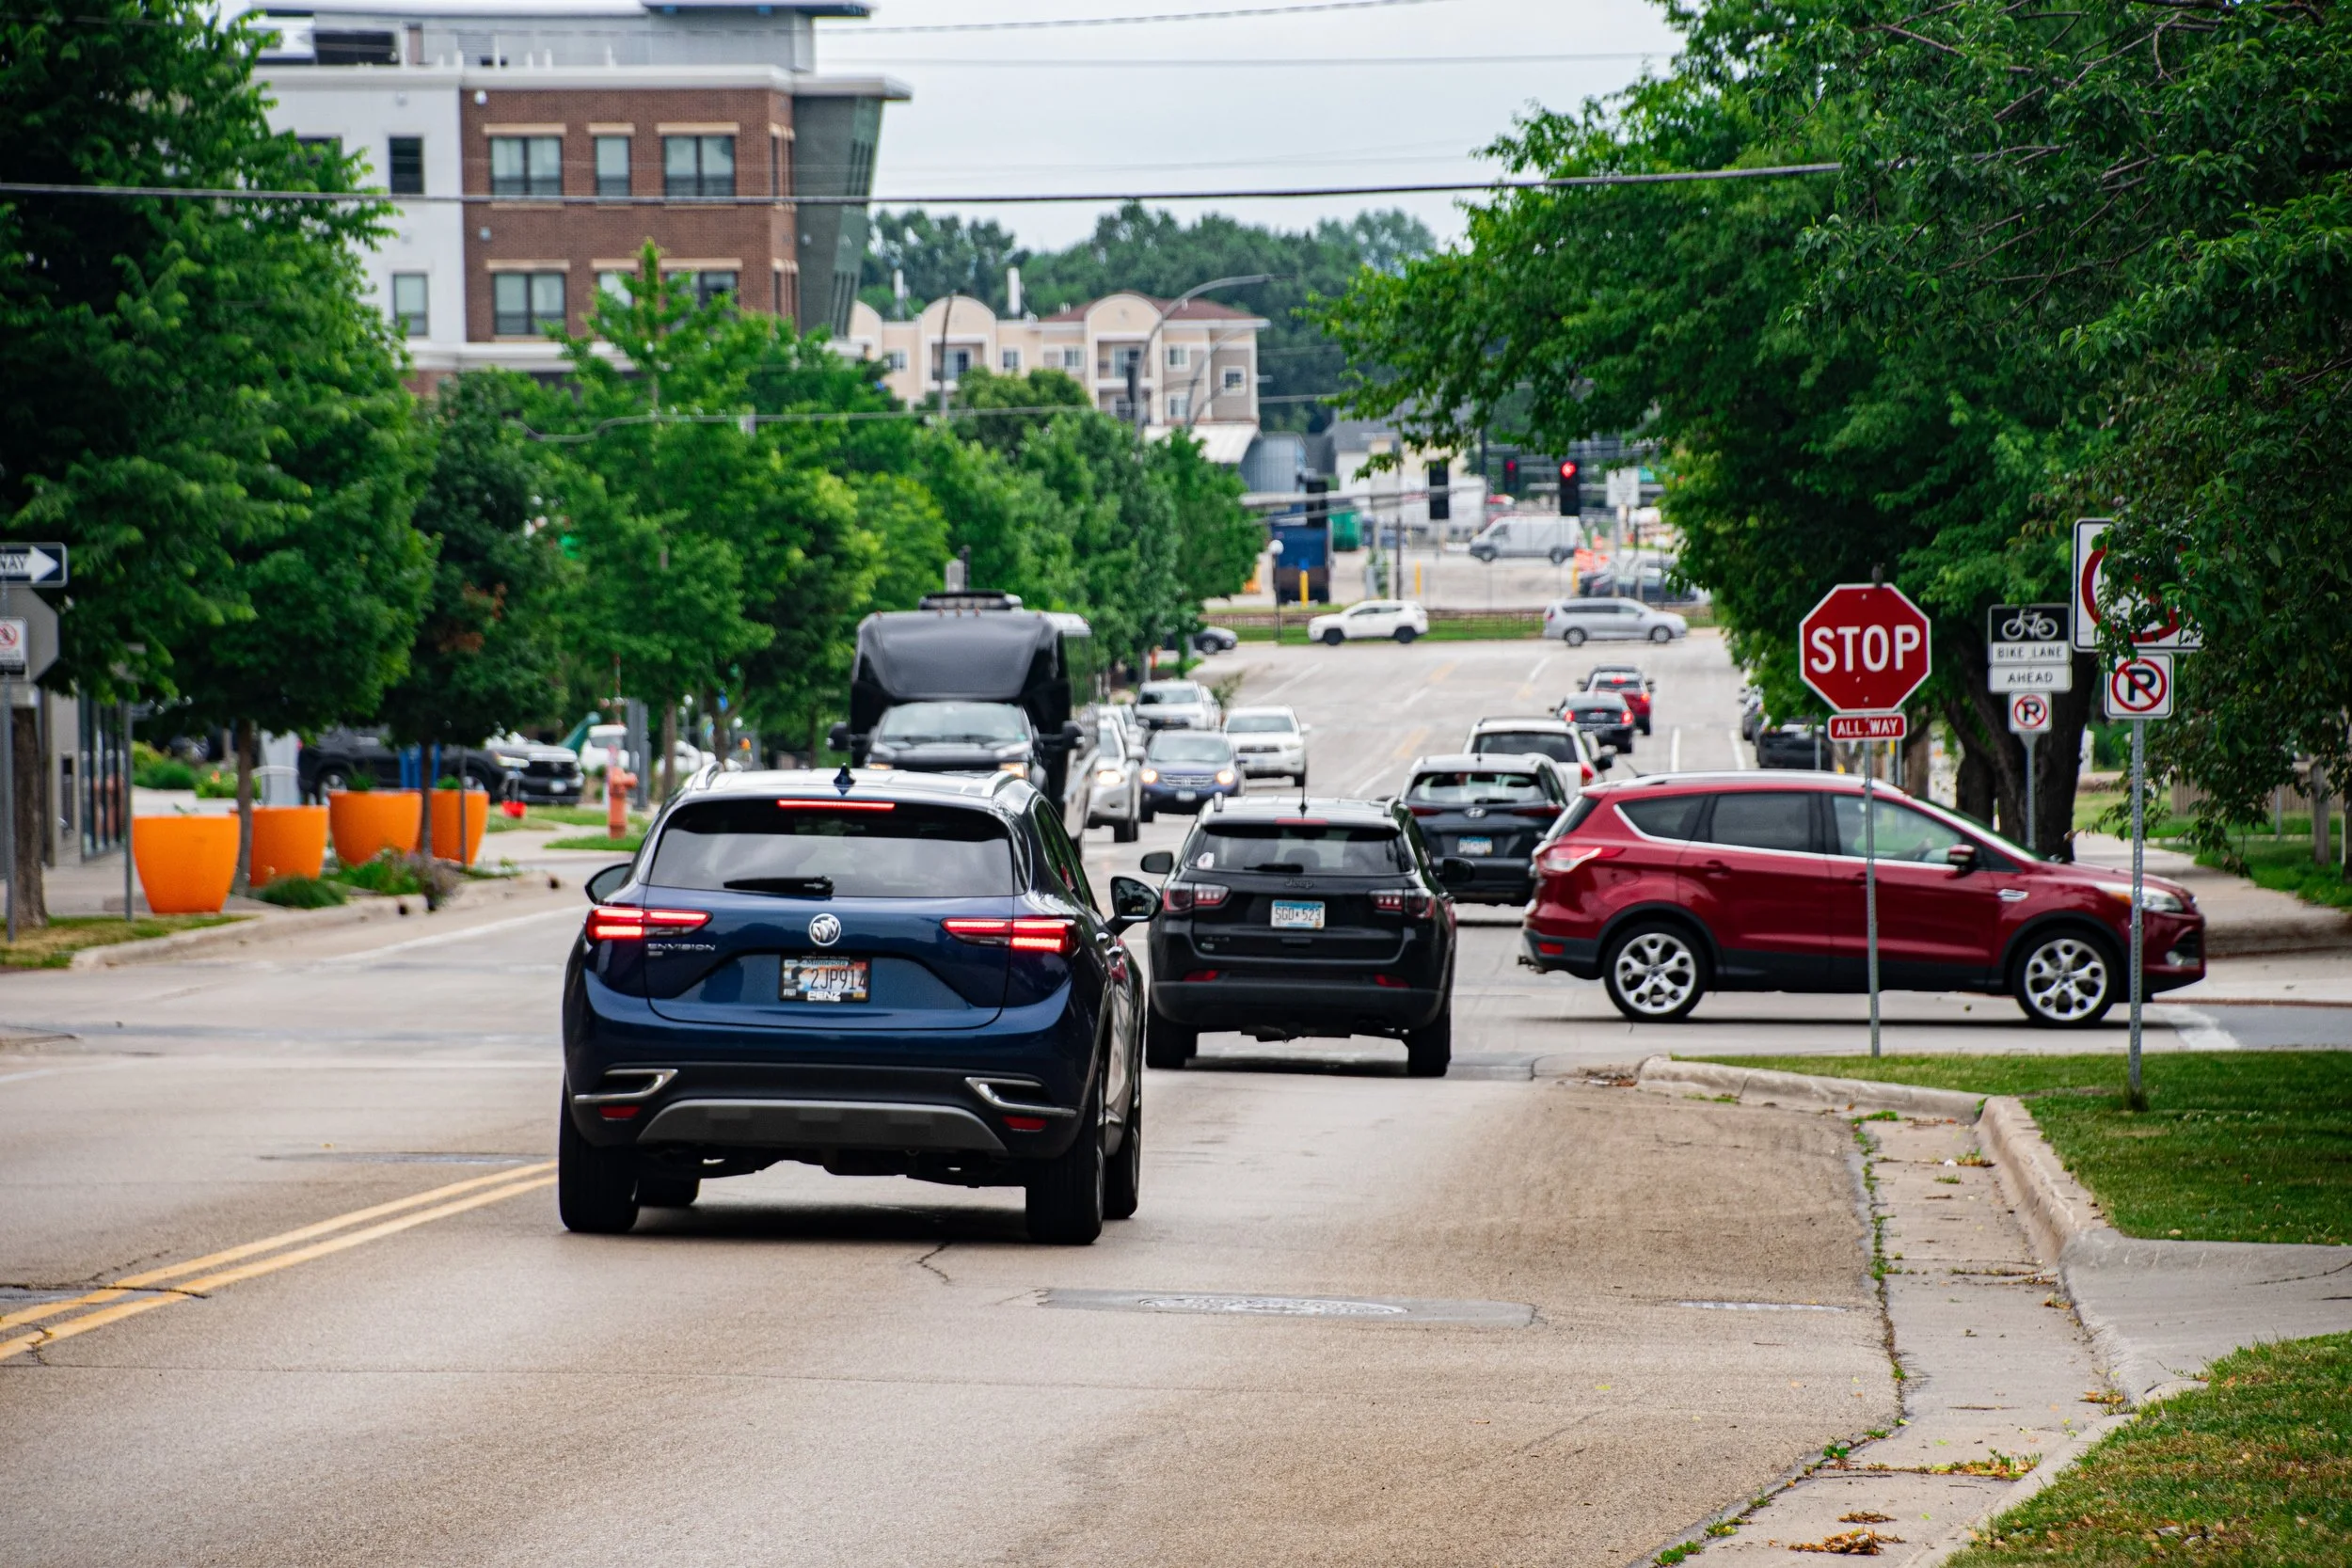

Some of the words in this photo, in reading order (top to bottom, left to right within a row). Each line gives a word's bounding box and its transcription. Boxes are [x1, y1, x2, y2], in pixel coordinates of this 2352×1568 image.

[1811, 625, 1920, 673] STOP
[1997, 646, 2025, 658] BIKE
[2032, 645, 2063, 658] LANE
[2007, 672, 2053, 684] AHEAD
[2127, 668, 2156, 702] P
[1836, 721, 1863, 736] ALL
[1868, 719, 1898, 735] WAY
[1284, 878, 1314, 889] Jeep
[810, 968, 866, 990] 2JP914
